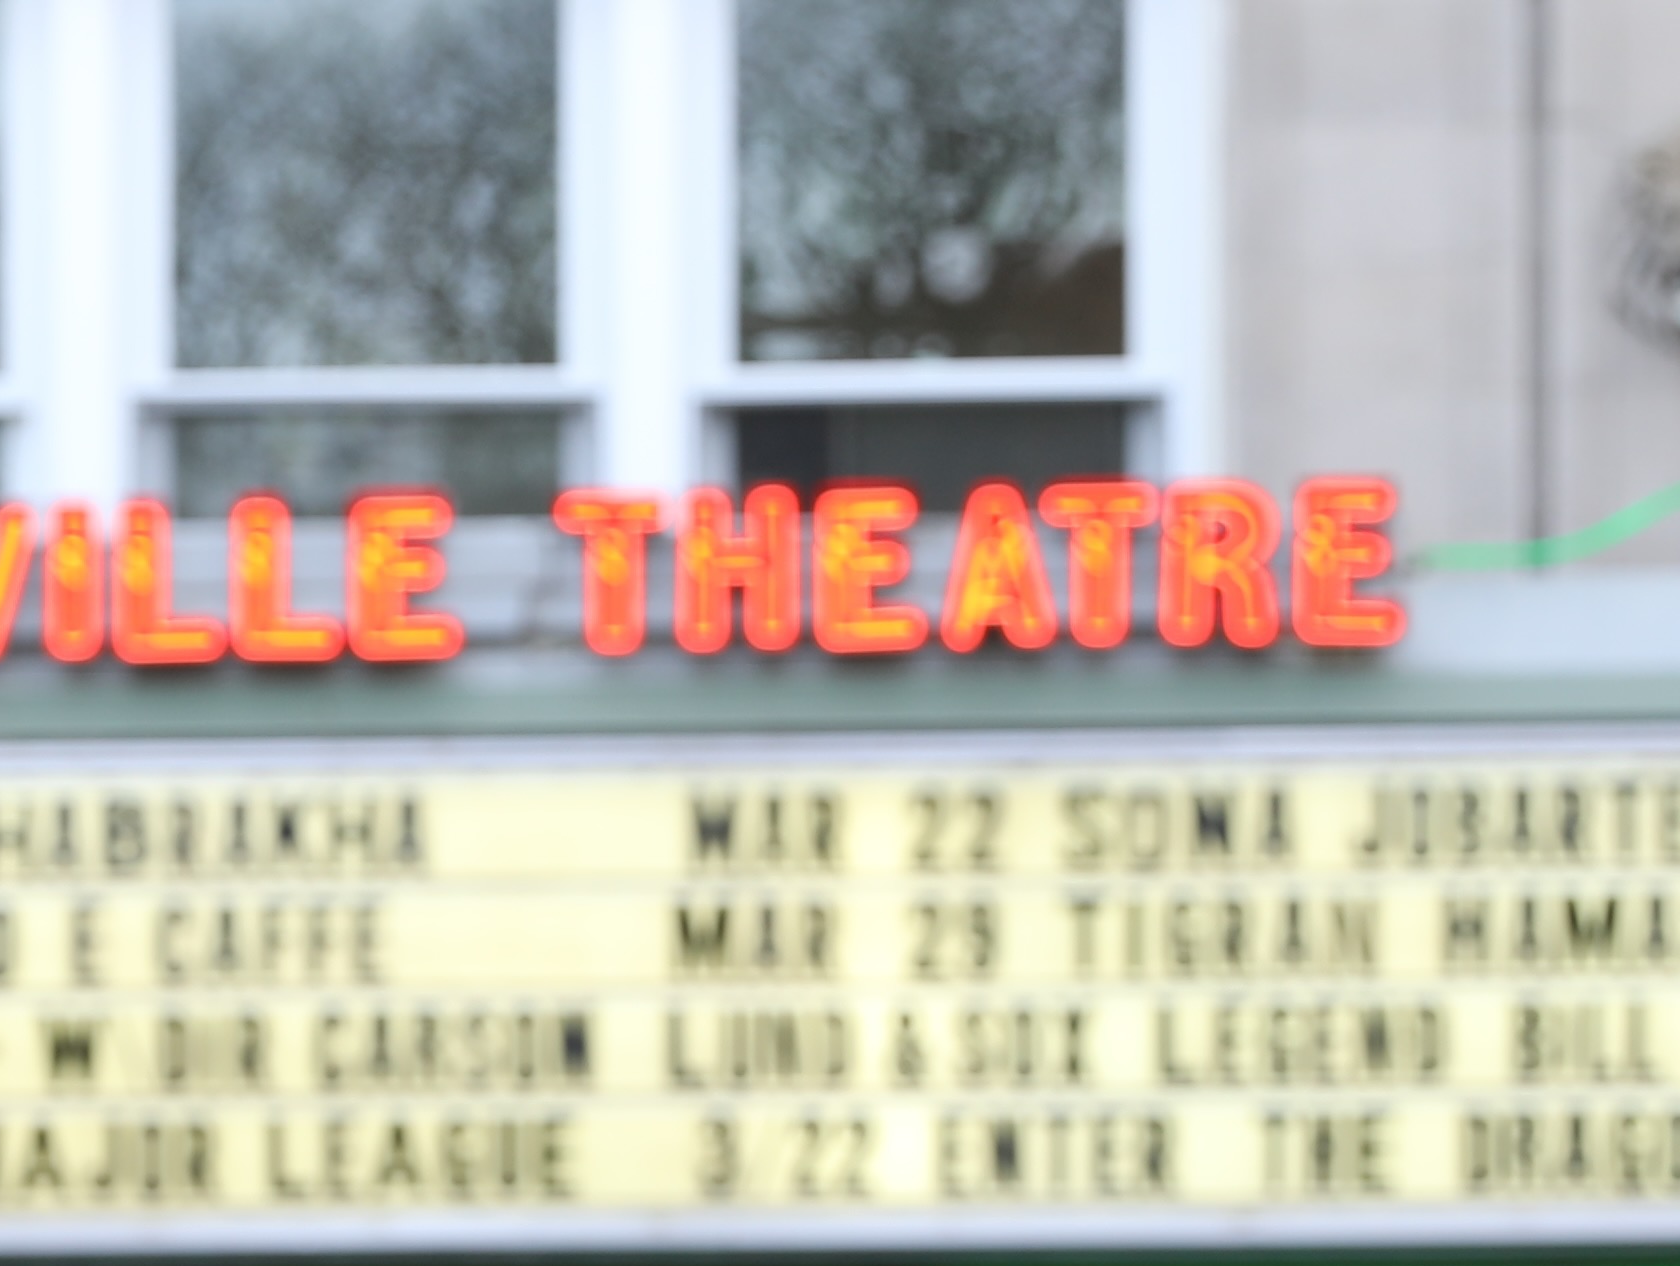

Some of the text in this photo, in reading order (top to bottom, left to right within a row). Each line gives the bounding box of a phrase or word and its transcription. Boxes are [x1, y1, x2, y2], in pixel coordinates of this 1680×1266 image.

[551, 474, 1409, 657] THEATRE
[685, 786, 846, 874] MAR
[906, 786, 1010, 874] 22
[1056, 784, 1302, 872] SONA
[70, 896, 108, 988] E
[154, 896, 388, 986] CAFFE
[668, 888, 840, 980] MAR
[906, 888, 1002, 980] 29
[1056, 884, 1382, 978] TIGRAN
[312, 1002, 596, 1094] CARSON
[664, 1000, 854, 1090] LUND
[1156, 998, 1450, 1086] LEGEND
[1512, 996, 1660, 1086] BILL
[264, 1112, 582, 1202] LEAGUE
[942, 1106, 1174, 1198] ENTER
[1260, 1104, 1398, 1196] THE
